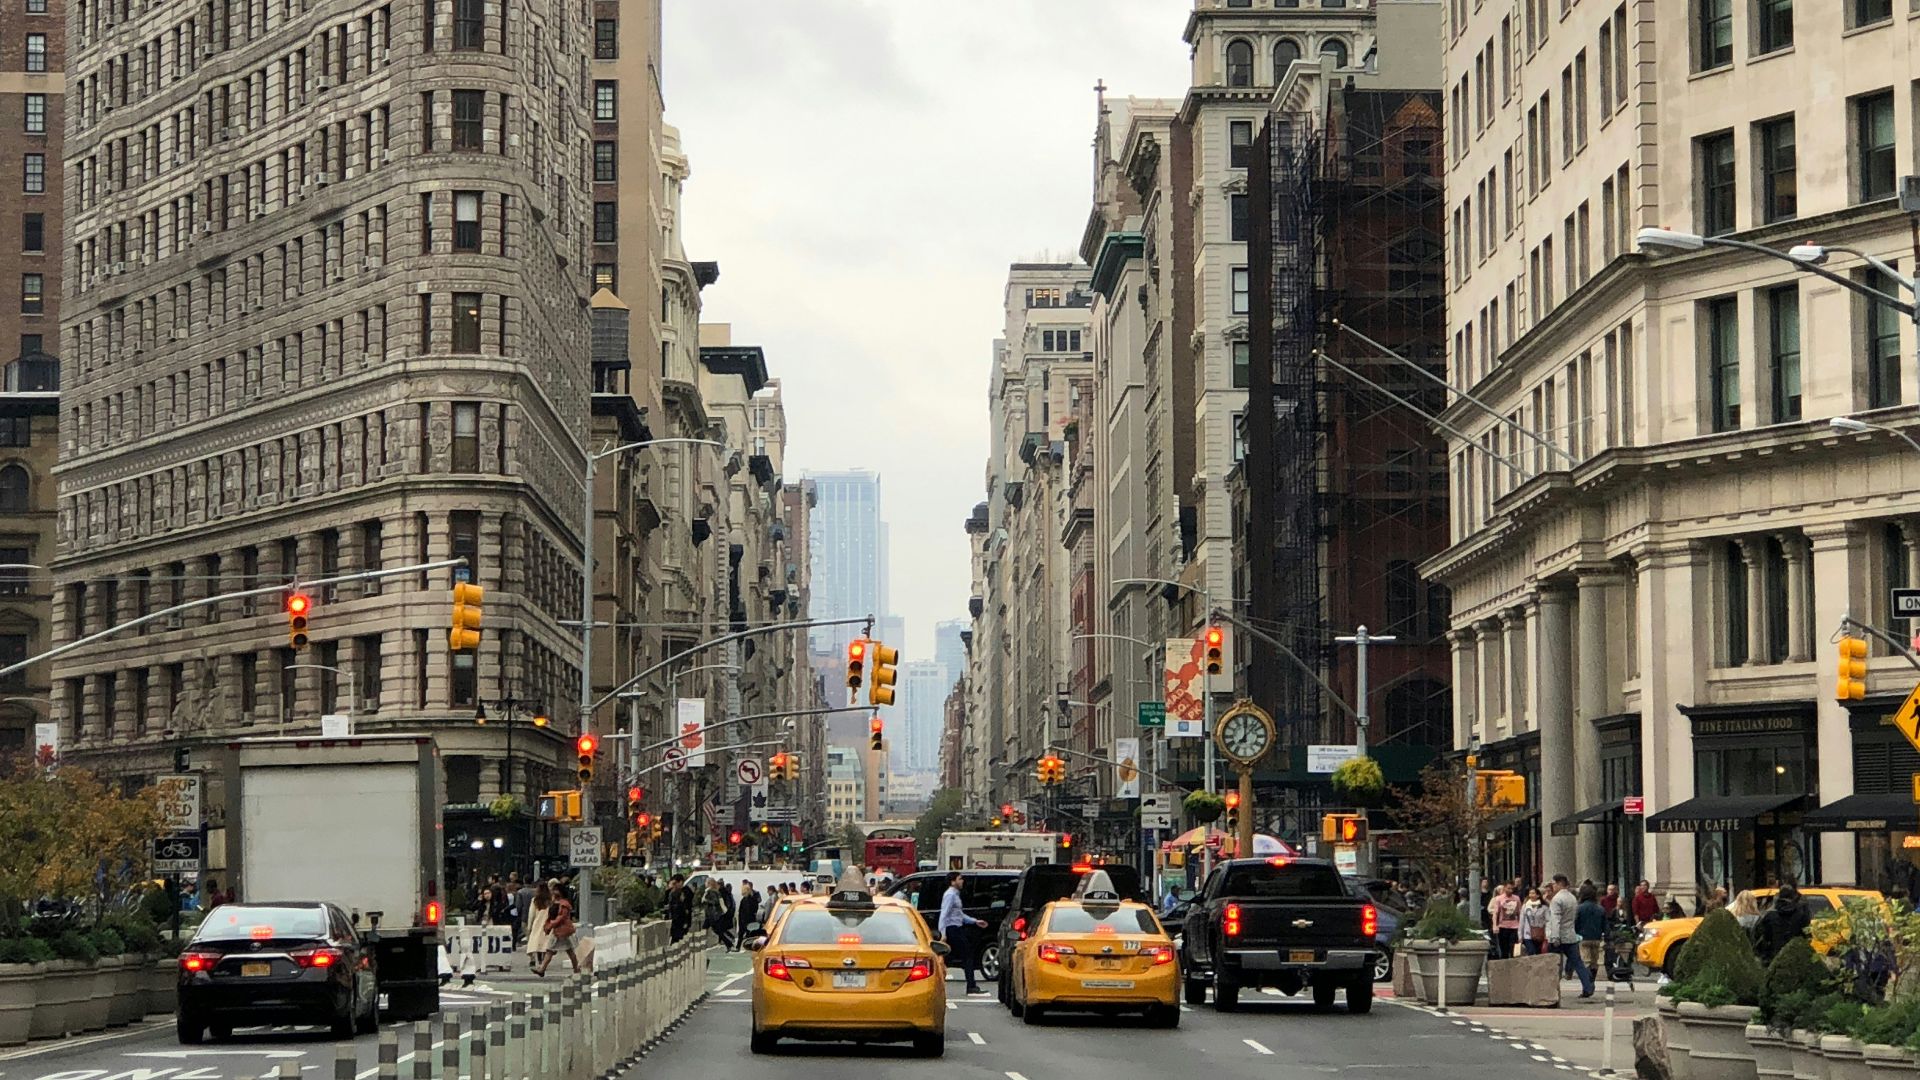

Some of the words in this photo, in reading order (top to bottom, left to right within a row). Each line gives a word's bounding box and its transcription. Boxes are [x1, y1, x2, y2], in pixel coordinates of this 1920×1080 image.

[1906, 597, 1920, 609] ON
[1700, 721, 1722, 732] FINE
[1725, 720, 1764, 731] ITALIAN
[1767, 718, 1793, 729] FOOD
[164, 803, 192, 817] RED
[1660, 820, 1700, 832] EATALY
[1705, 818, 1740, 831] CAFFE
[575, 847, 595, 855] LANE
[178, 860, 198, 870] LANE
[573, 856, 599, 864] AHEAD
